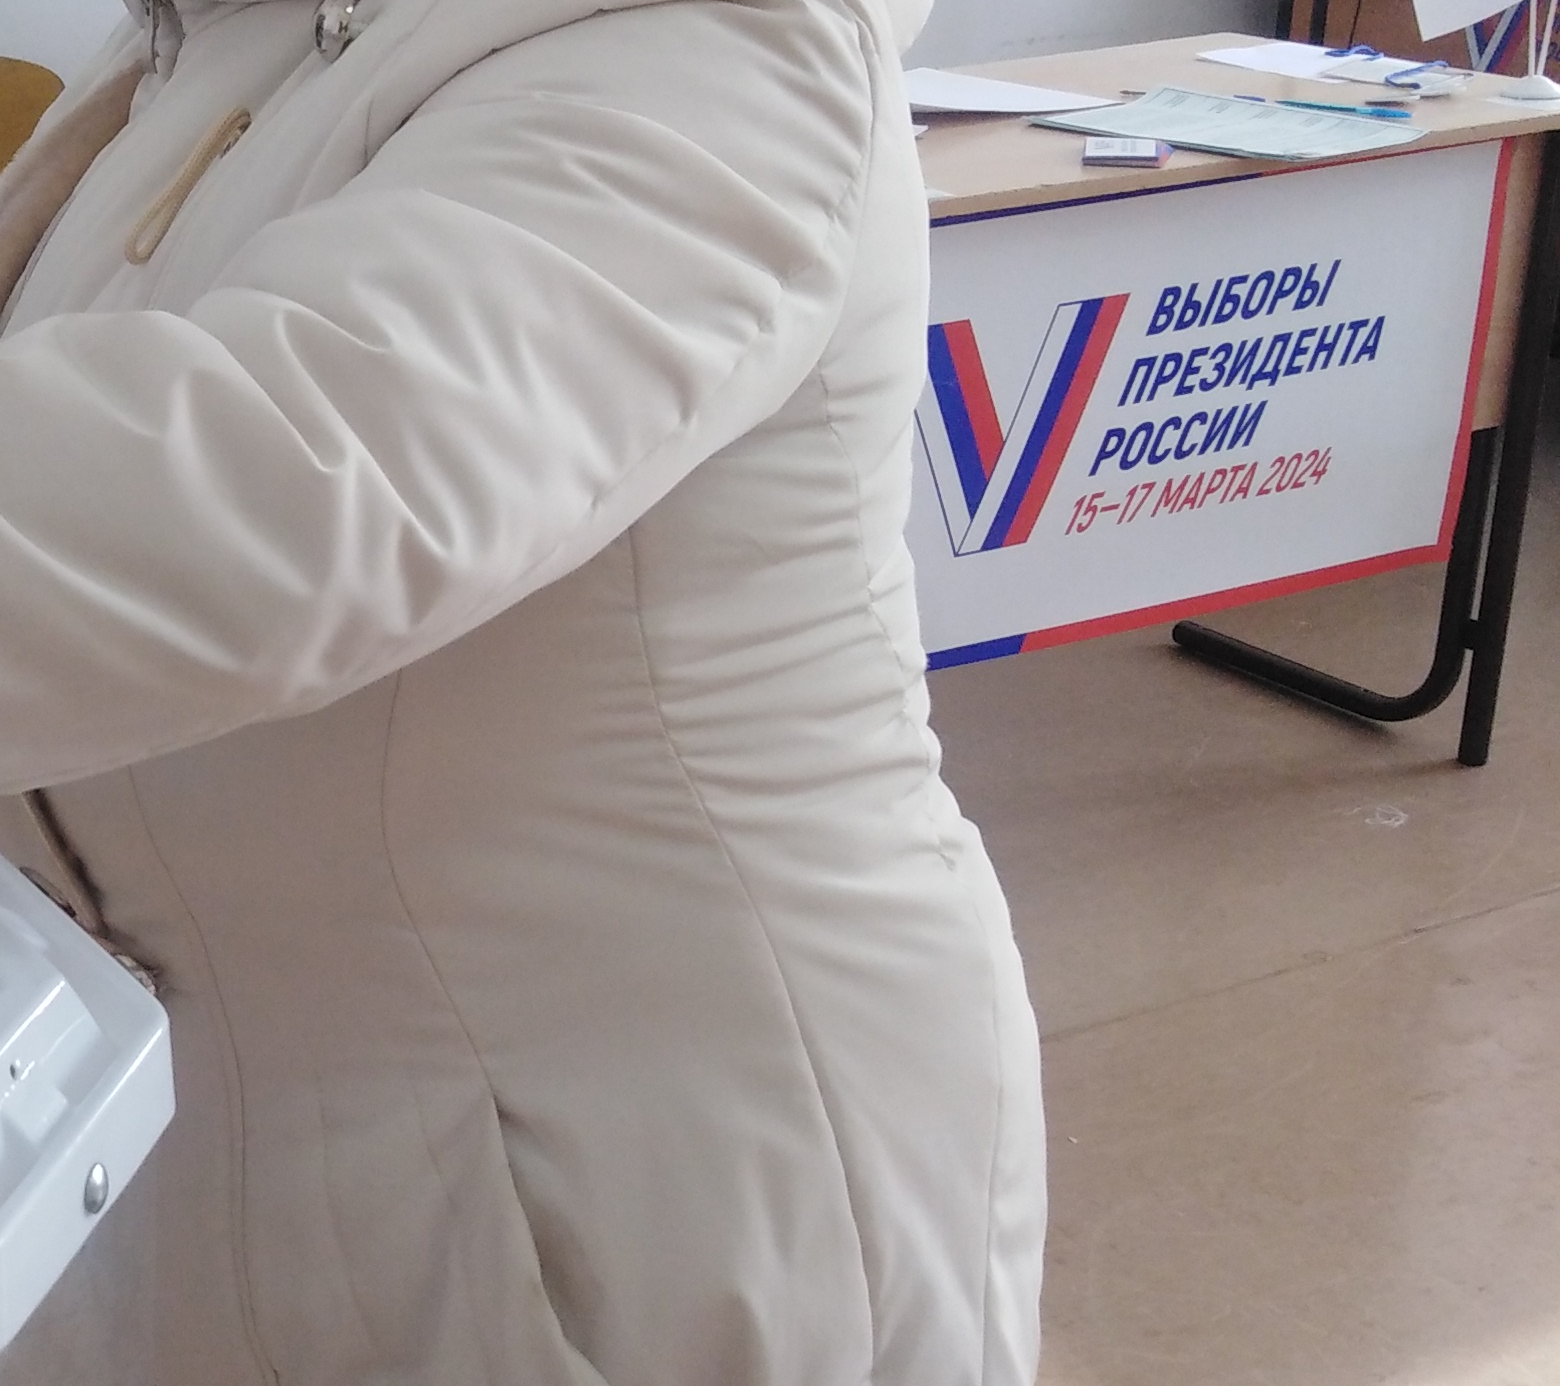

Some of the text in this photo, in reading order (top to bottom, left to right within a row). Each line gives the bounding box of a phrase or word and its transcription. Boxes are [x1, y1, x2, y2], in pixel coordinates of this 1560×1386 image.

[1146, 260, 1341, 336] ВЫБОРЫ
[1117, 315, 1385, 407] ПРЕЗИДЕНТА
[1088, 400, 1267, 477] РОССИИ
[1151, 464, 1252, 523] МАРТА
[1256, 447, 1332, 497] 2024
